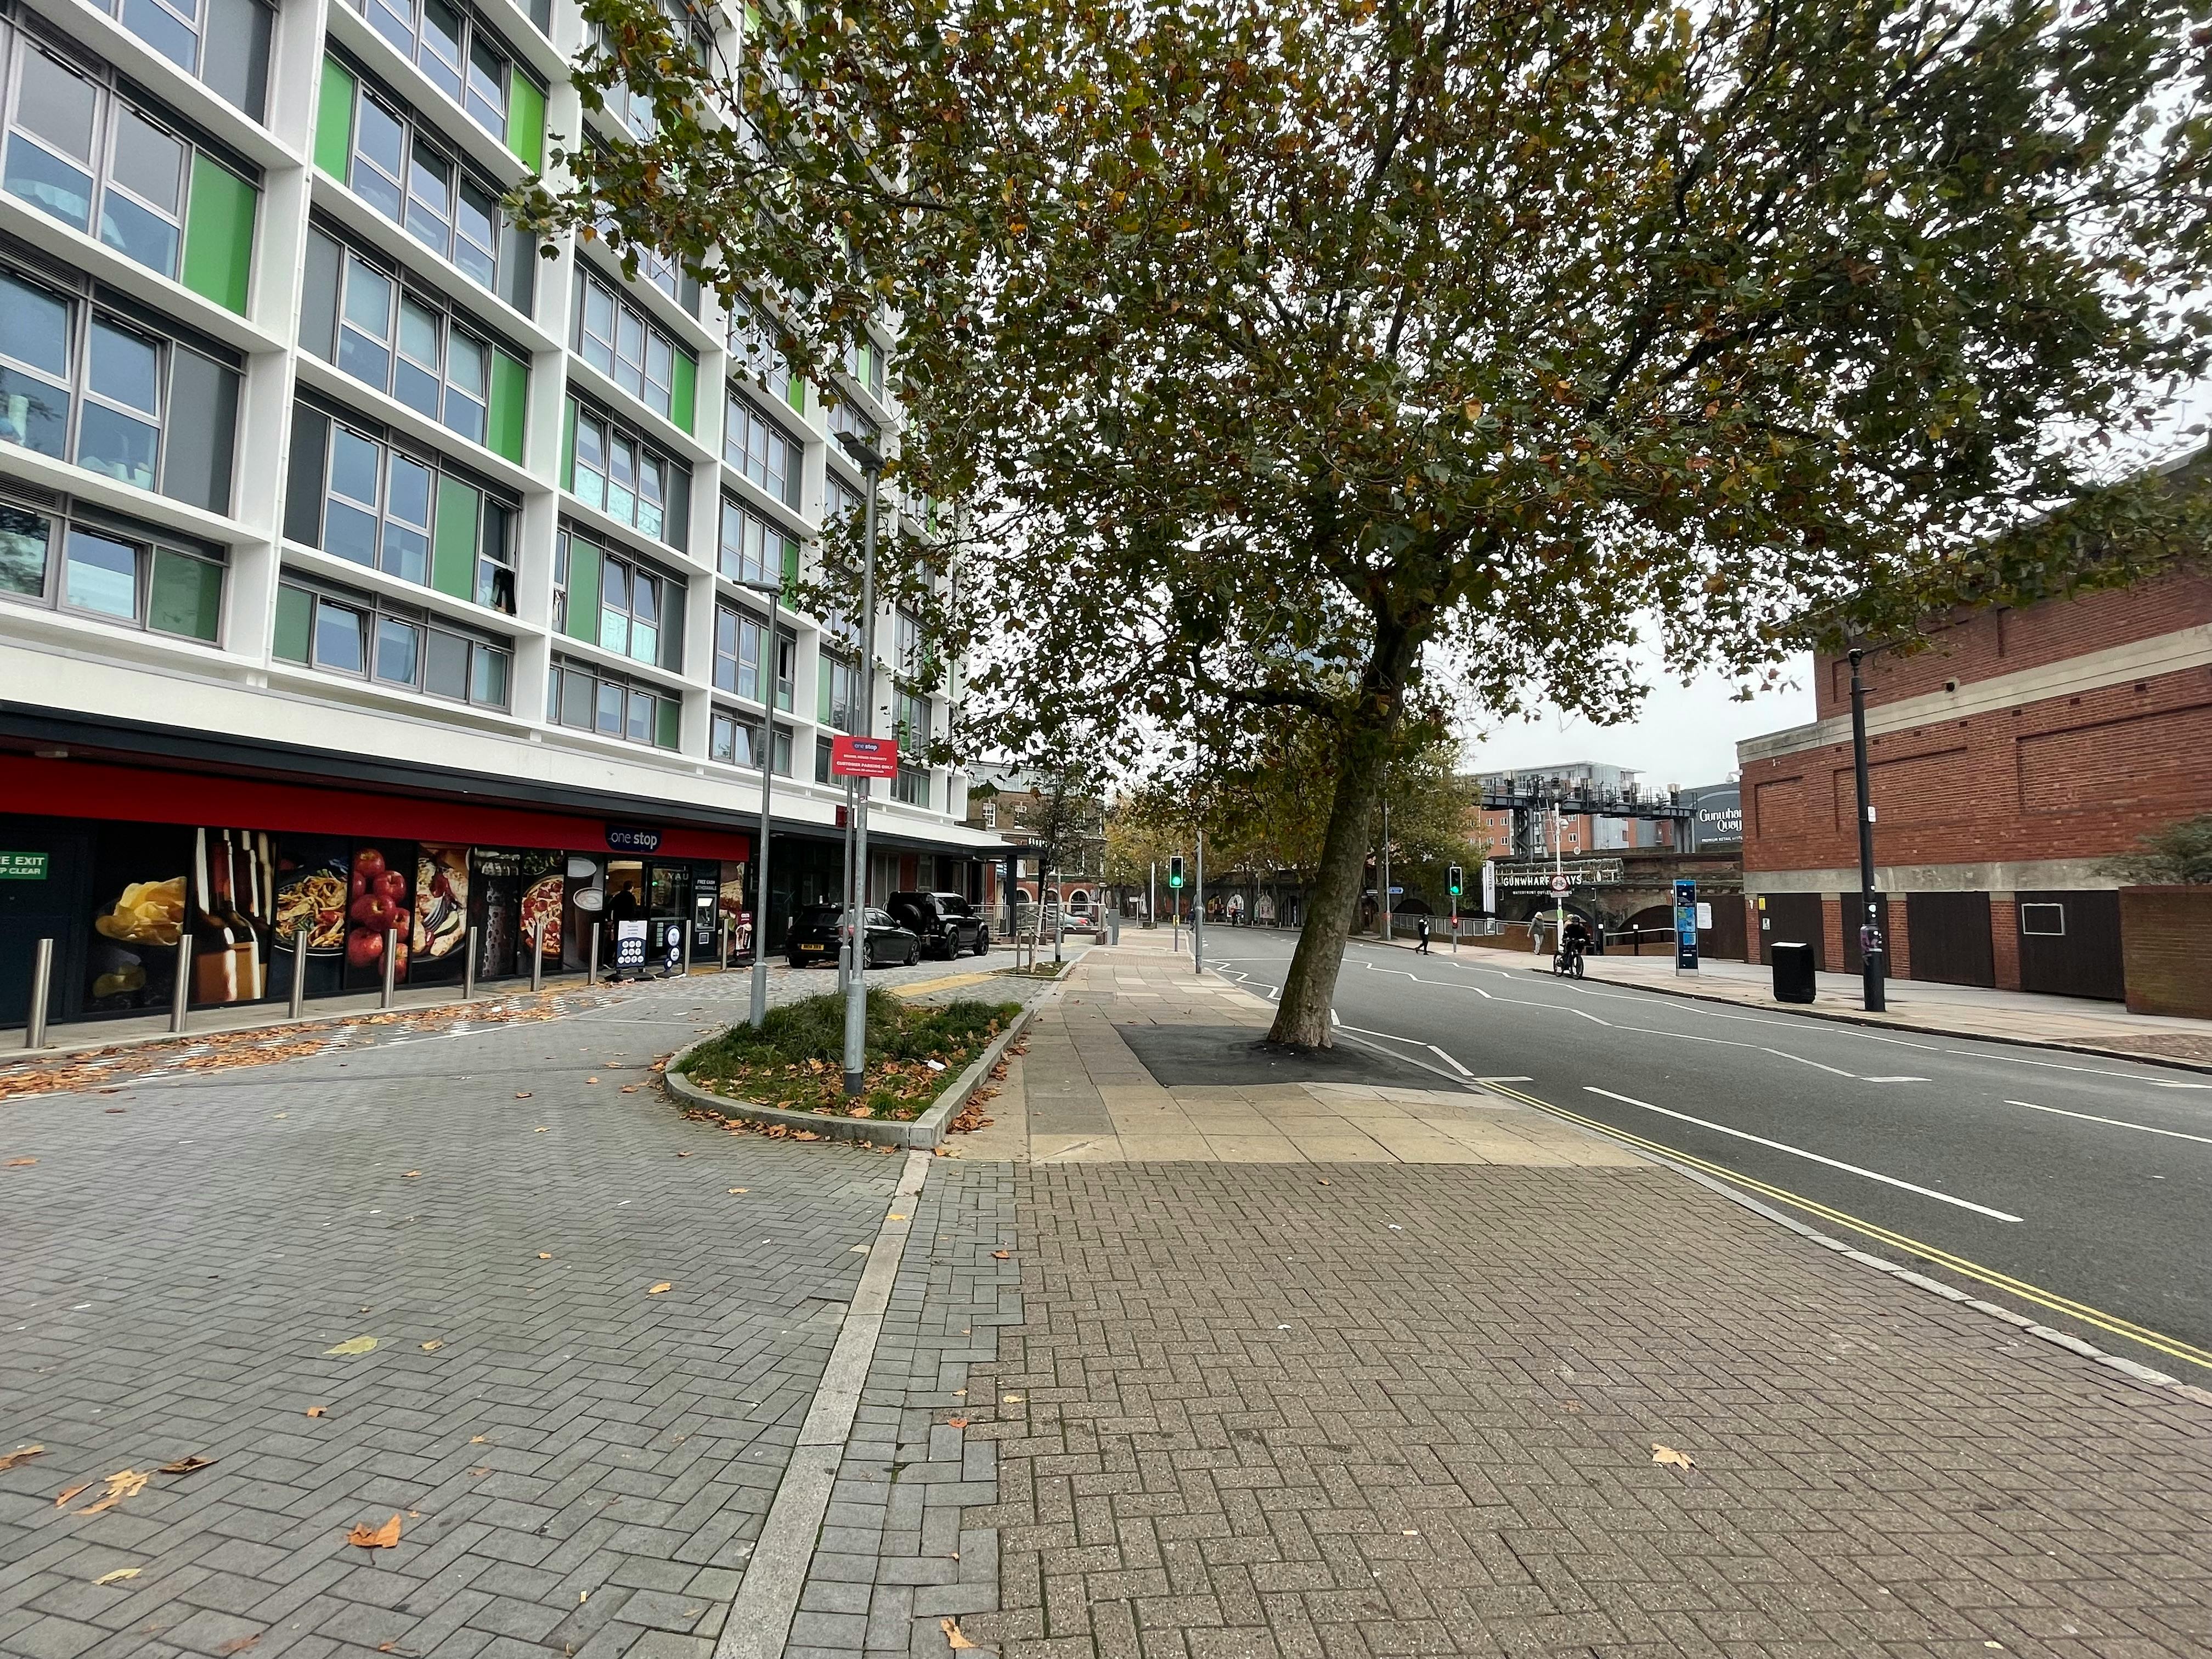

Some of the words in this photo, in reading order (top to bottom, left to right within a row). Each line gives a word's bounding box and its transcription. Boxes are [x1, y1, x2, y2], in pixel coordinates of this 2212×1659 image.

[611, 832, 631, 843] one
[634, 832, 657, 849] stop
[0, 856, 10, 865] E
[15, 856, 45, 866] EXIT
[1503, 876, 1550, 886] GUNWHARF
